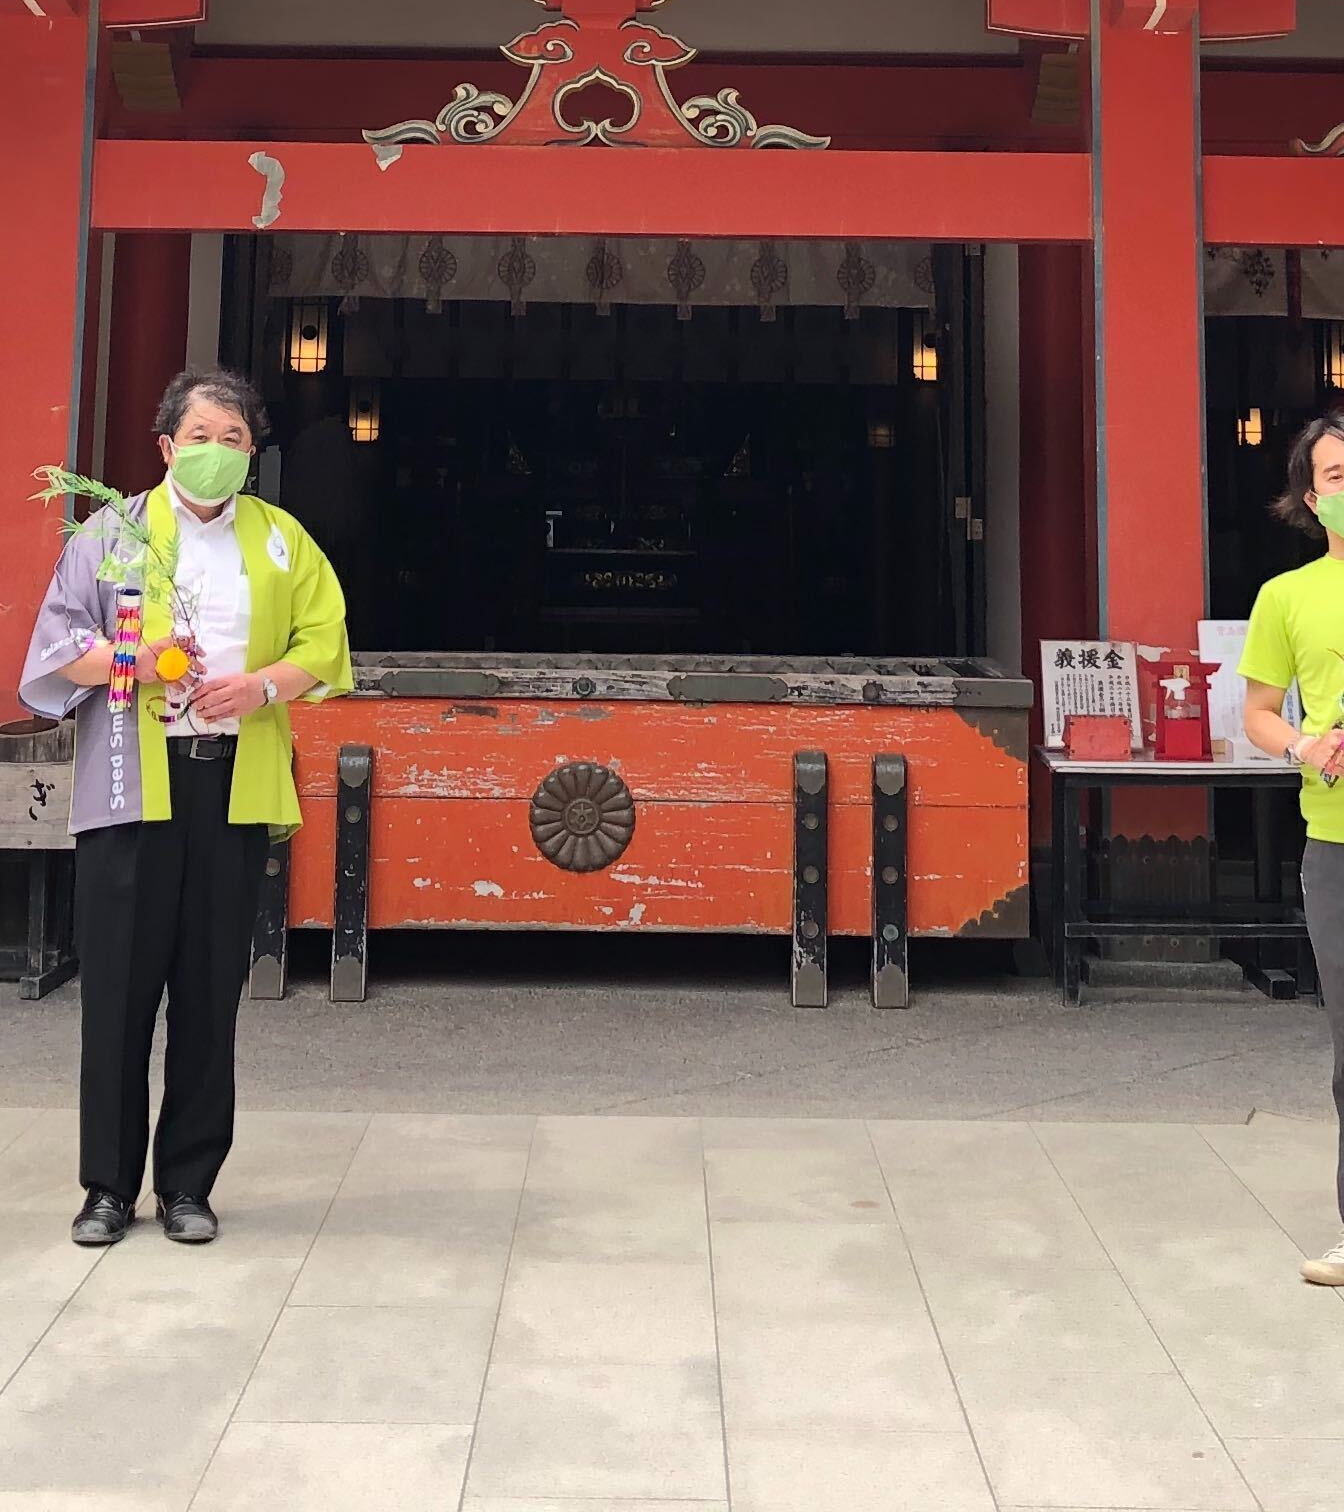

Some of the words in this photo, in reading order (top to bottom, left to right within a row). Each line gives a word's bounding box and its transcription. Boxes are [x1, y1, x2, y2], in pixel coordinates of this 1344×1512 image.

[1054, 648, 1125, 670] 義援金
[110, 754, 125, 810] Seed
